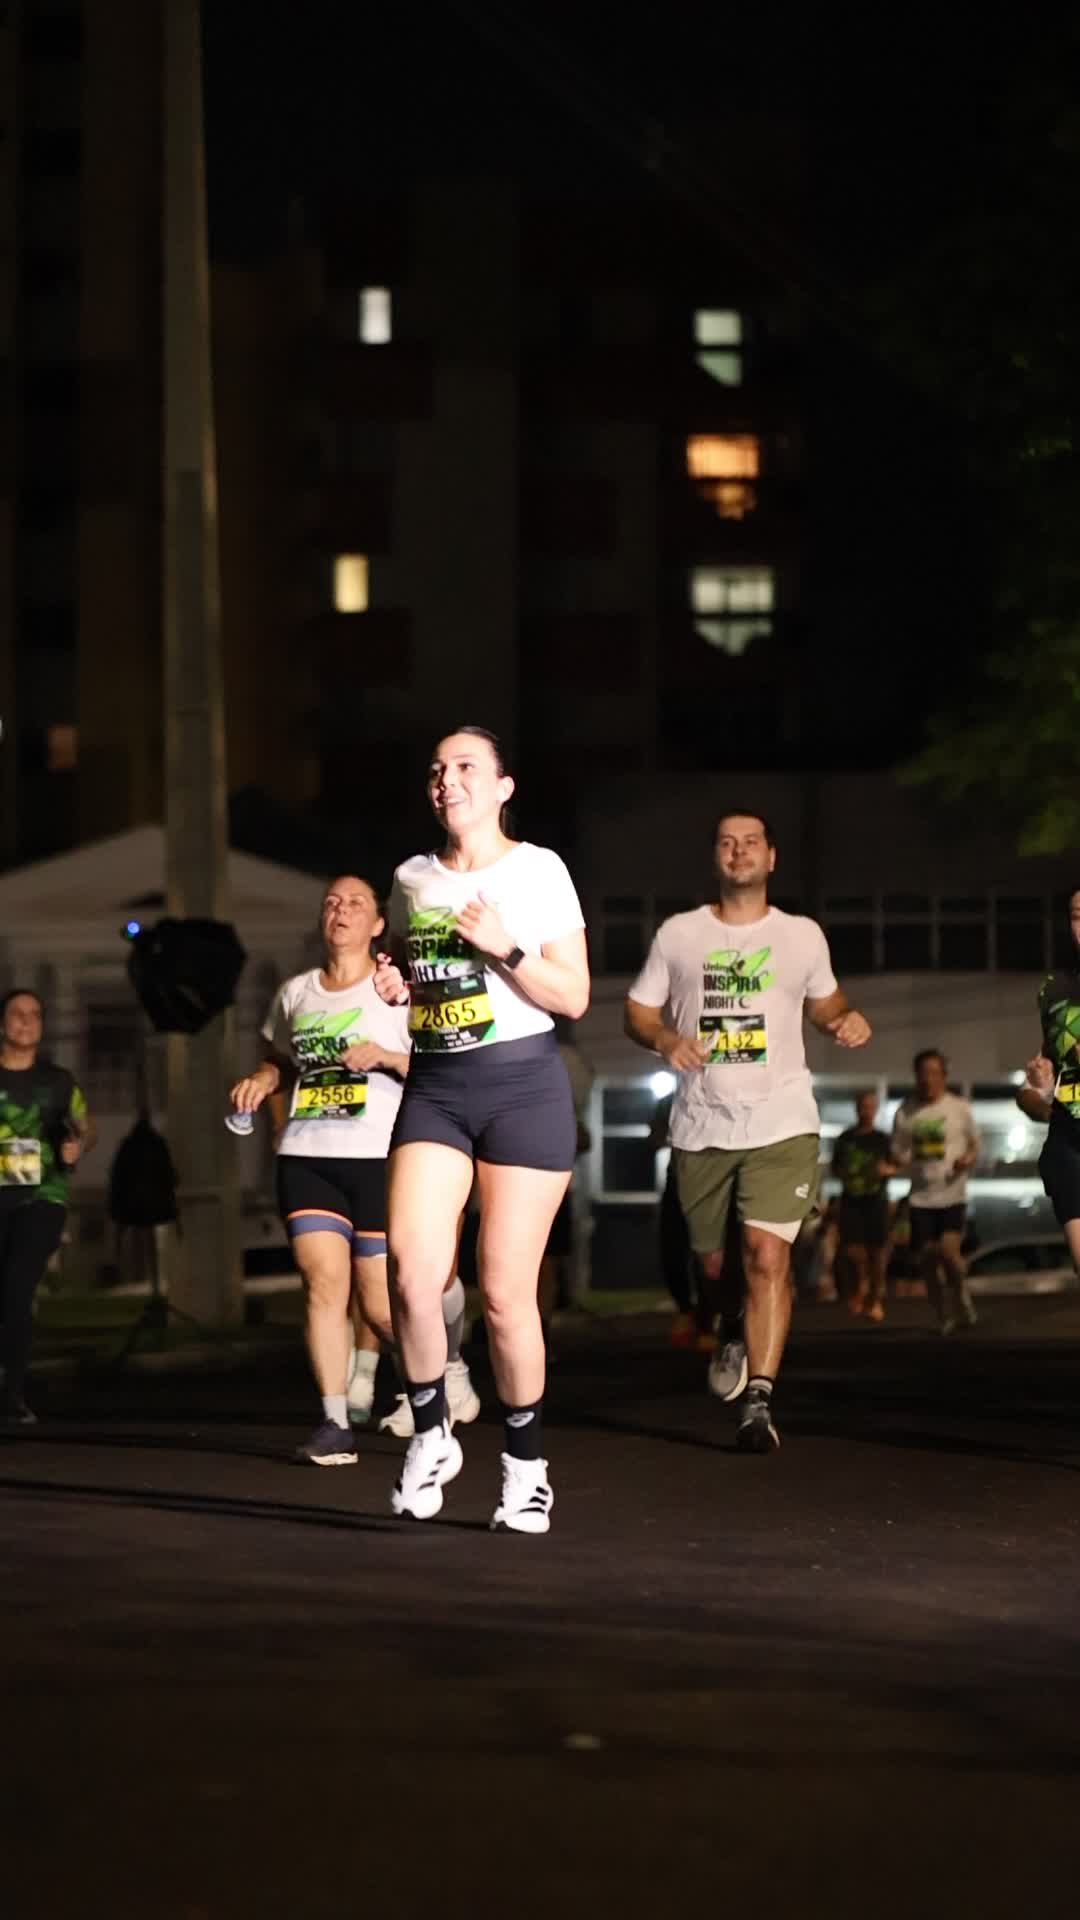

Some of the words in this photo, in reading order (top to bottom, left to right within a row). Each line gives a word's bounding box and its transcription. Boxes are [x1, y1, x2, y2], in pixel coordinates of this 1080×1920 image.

[703, 974, 762, 992] INSPIRA
[703, 996, 735, 1010] NIGHT
[421, 1001, 477, 1029] 2865
[709, 1031, 755, 1049] 132
[308, 1085, 355, 1106] 2556
